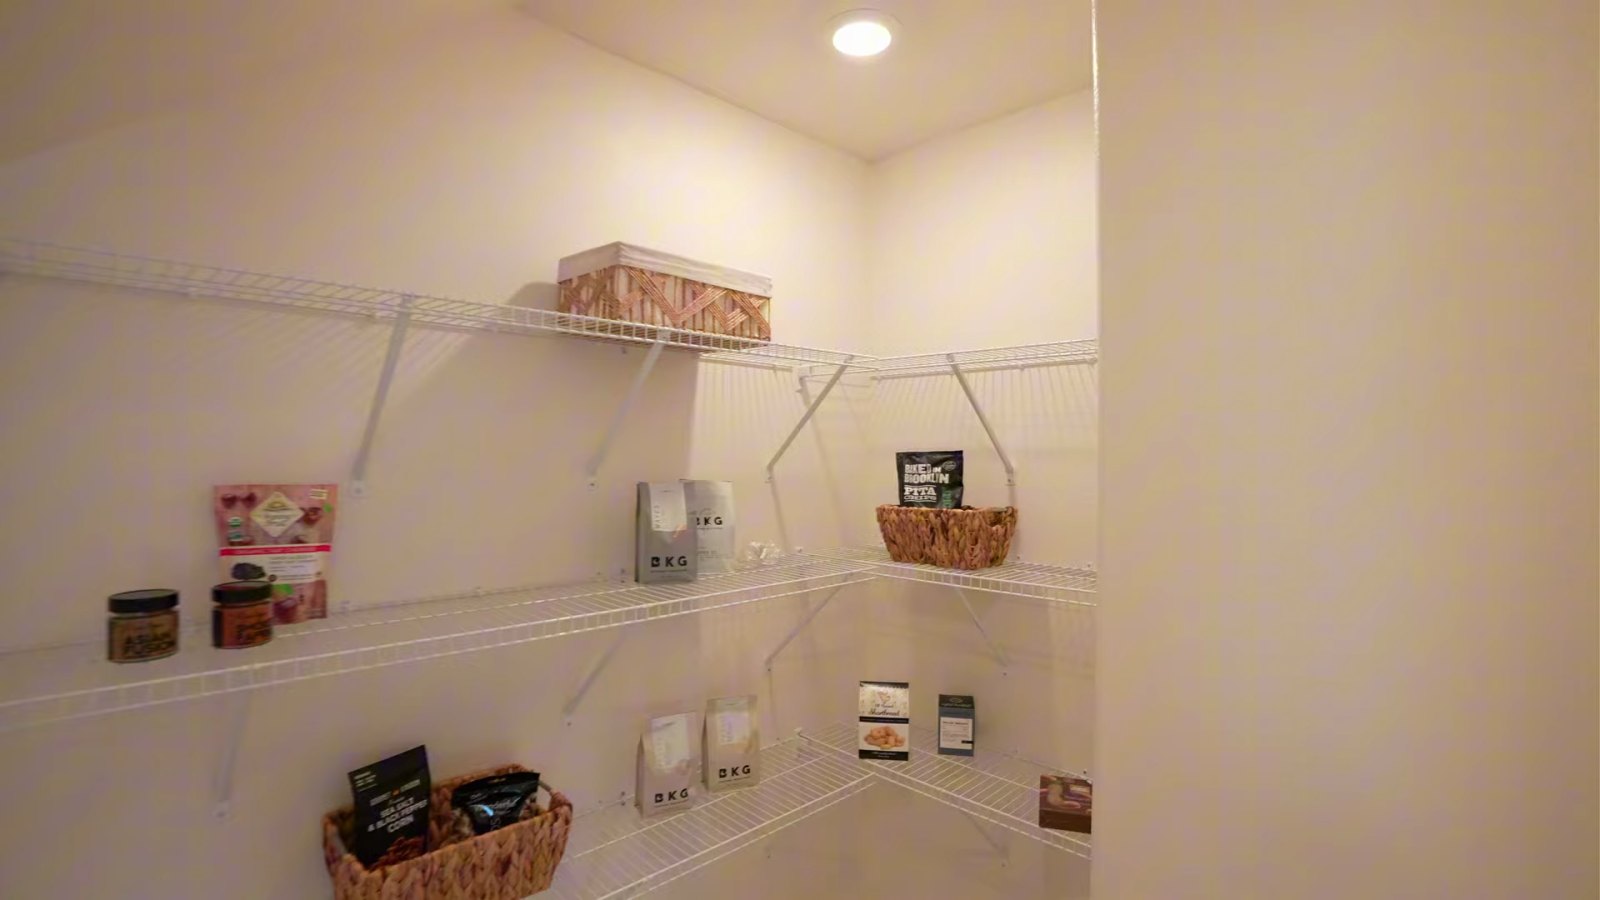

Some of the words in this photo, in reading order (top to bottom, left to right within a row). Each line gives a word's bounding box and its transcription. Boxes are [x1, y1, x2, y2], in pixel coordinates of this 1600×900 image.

[904, 464, 932, 473] BAKED
[904, 473, 950, 484] BROOKLYN
[651, 556, 688, 568] BKG
[719, 765, 751, 779] BKG
[654, 788, 689, 803] BKG
[380, 806, 396, 818] SEA
[396, 797, 414, 811] SALT
[387, 814, 414, 833] CORN
